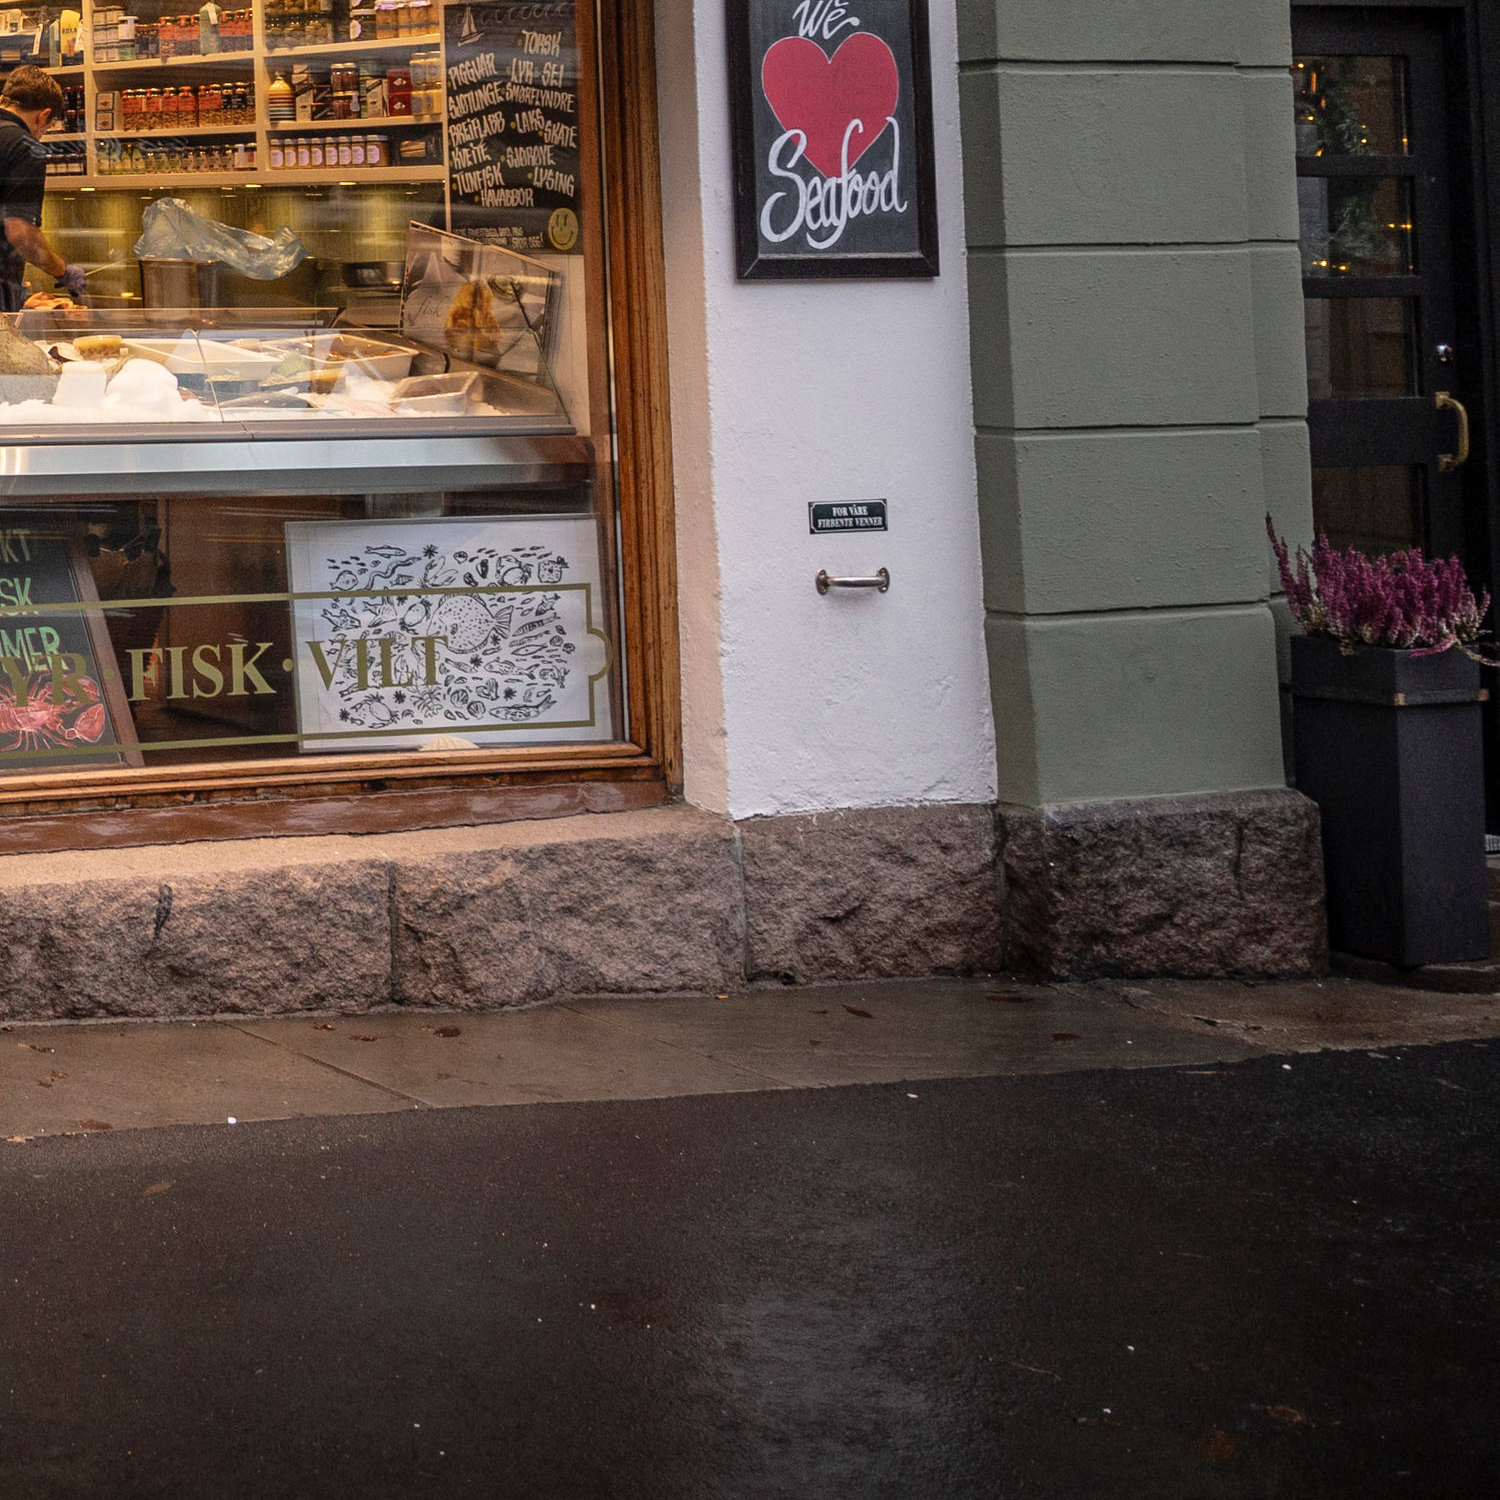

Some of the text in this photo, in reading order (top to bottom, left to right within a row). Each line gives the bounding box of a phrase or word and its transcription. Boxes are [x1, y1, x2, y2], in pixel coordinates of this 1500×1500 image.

[521, 29, 562, 58] TORSK
[449, 52, 498, 90] PIGGVAR
[510, 58, 534, 84] LYR
[542, 62, 564, 88] SEI
[514, 108, 546, 134] LAKS
[543, 119, 578, 149] SKATE
[452, 162, 575, 198] TUNFISK LYSING
[480, 187, 535, 208] HAVABBOR
[759, 115, 908, 250] Seafood
[831, 503, 869, 517] FOR VÅRE
[125, 641, 277, 702] FISK
[306, 634, 449, 693] VILT
